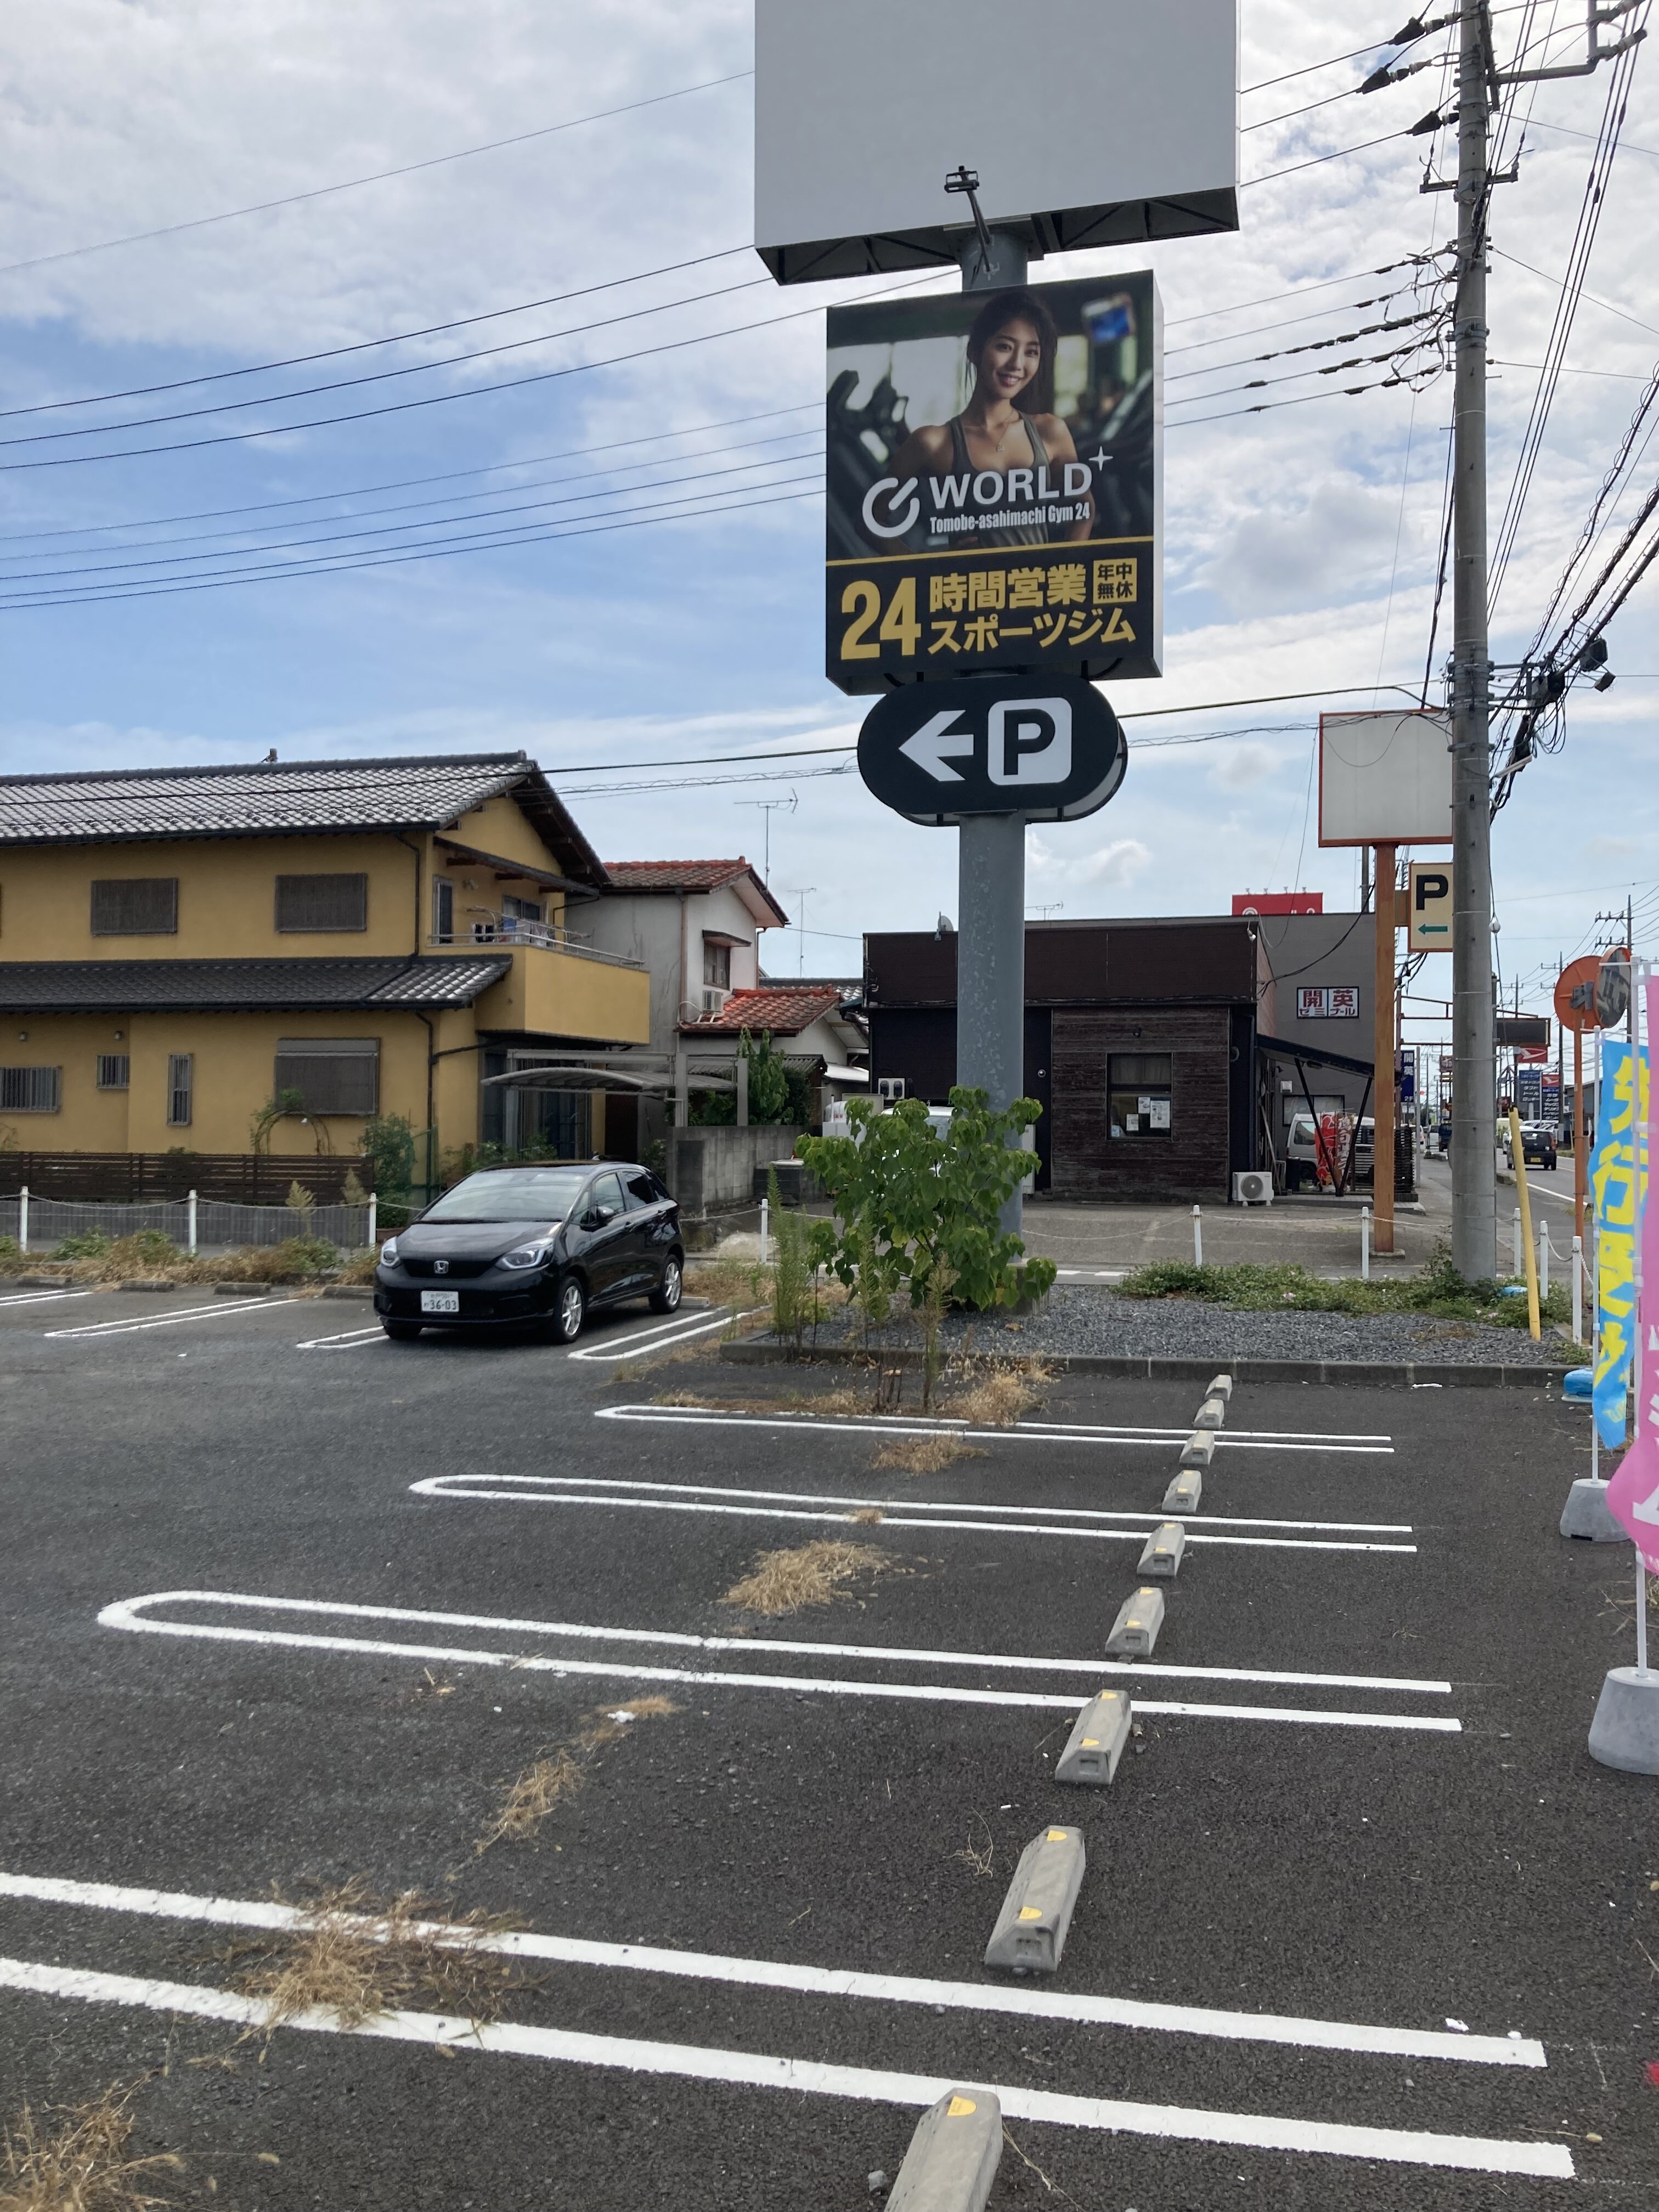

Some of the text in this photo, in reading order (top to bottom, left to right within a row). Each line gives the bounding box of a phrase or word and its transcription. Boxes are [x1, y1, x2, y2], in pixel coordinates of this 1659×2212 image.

[929, 462, 1093, 510] WORLD
[929, 501, 1091, 534] Tomobe-asahimachi Gym 24
[1097, 562, 1133, 581] 年中
[1097, 581, 1133, 600] 無休
[840, 562, 1087, 661] 24 時間営業
[927, 607, 1137, 655] スポーツジム
[1003, 708, 1056, 776] P
[1415, 873, 1449, 911] P
[1299, 1008, 1356, 1017] ゼミナール
[1302, 989, 1354, 1008] 開英
